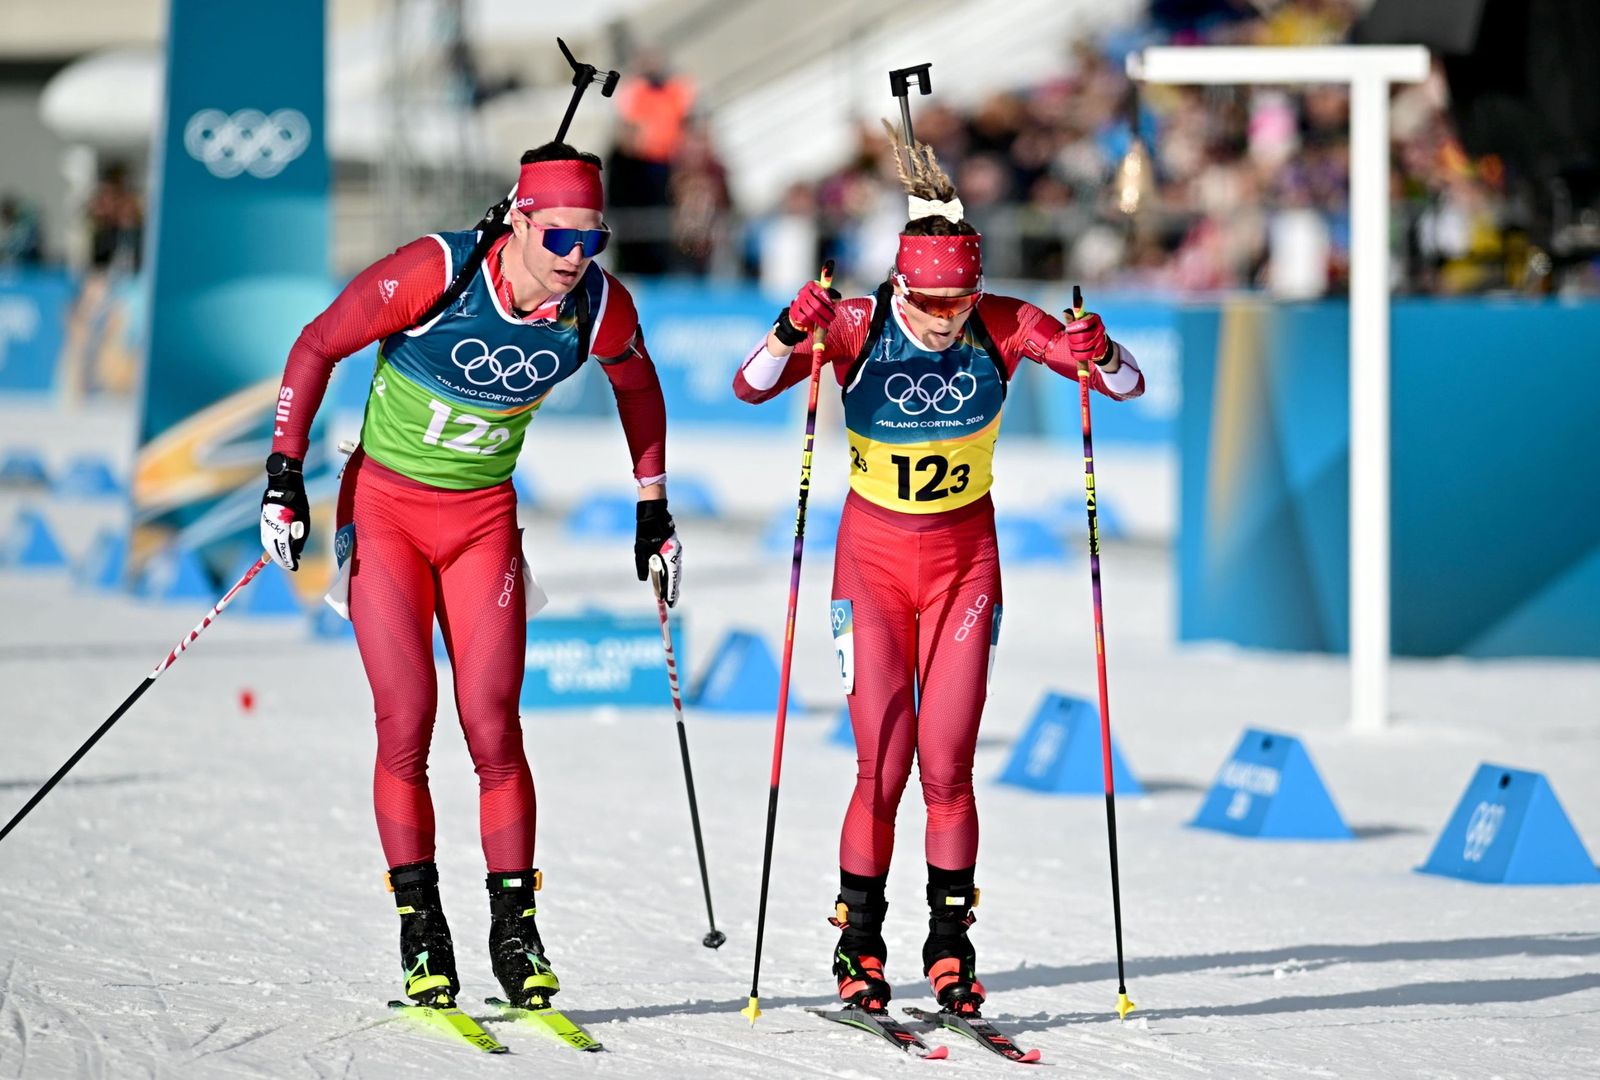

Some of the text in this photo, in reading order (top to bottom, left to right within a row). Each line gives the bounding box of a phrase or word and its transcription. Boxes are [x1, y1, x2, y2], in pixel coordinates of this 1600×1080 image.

[276, 386, 294, 422] SUI
[435, 374, 478, 396] MILANO
[478, 391, 524, 402] CORTINA
[875, 414, 985, 428] MILANO CORTINA 2026
[800, 434, 815, 491] LEKI
[1083, 457, 1096, 511] LEKI
[497, 556, 518, 608] odlo
[954, 593, 989, 642] odlo
